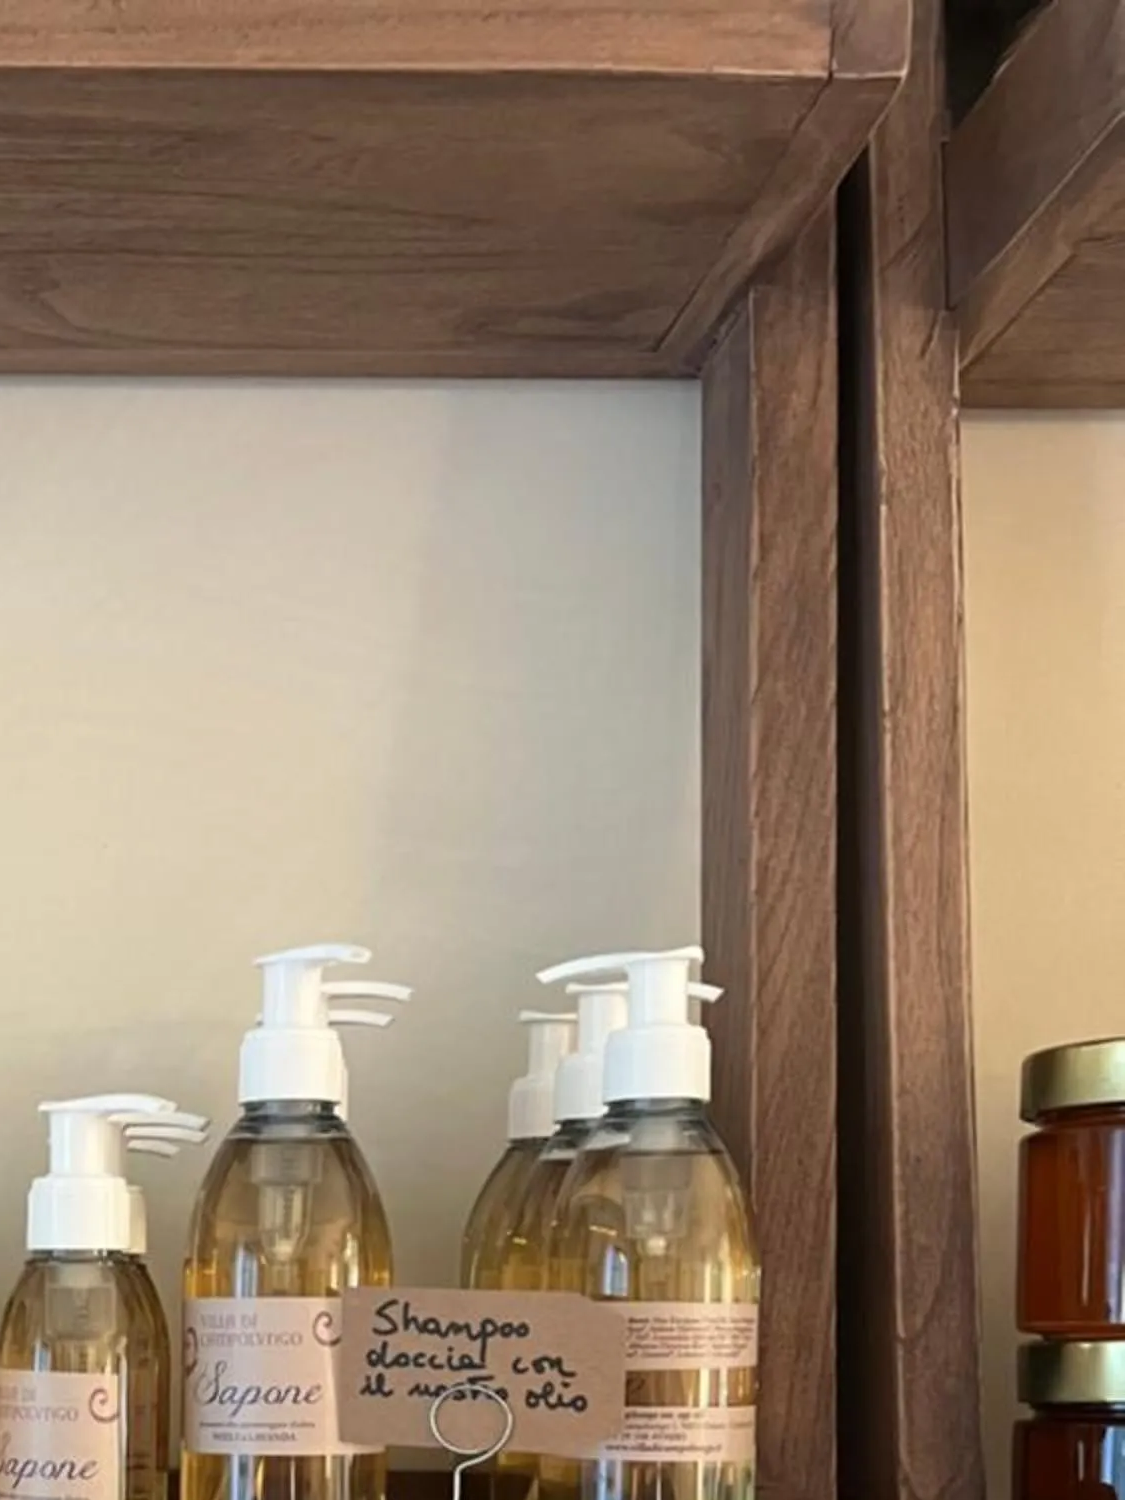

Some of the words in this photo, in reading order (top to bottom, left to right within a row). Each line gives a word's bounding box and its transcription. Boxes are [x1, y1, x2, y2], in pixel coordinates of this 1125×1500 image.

[372, 1299, 530, 1368] Shampoo
[366, 1341, 485, 1371] doccia
[512, 1355, 577, 1377] con
[194, 1360, 323, 1418] Sapone
[360, 1373, 393, 1397] il
[525, 1381, 589, 1413] olio
